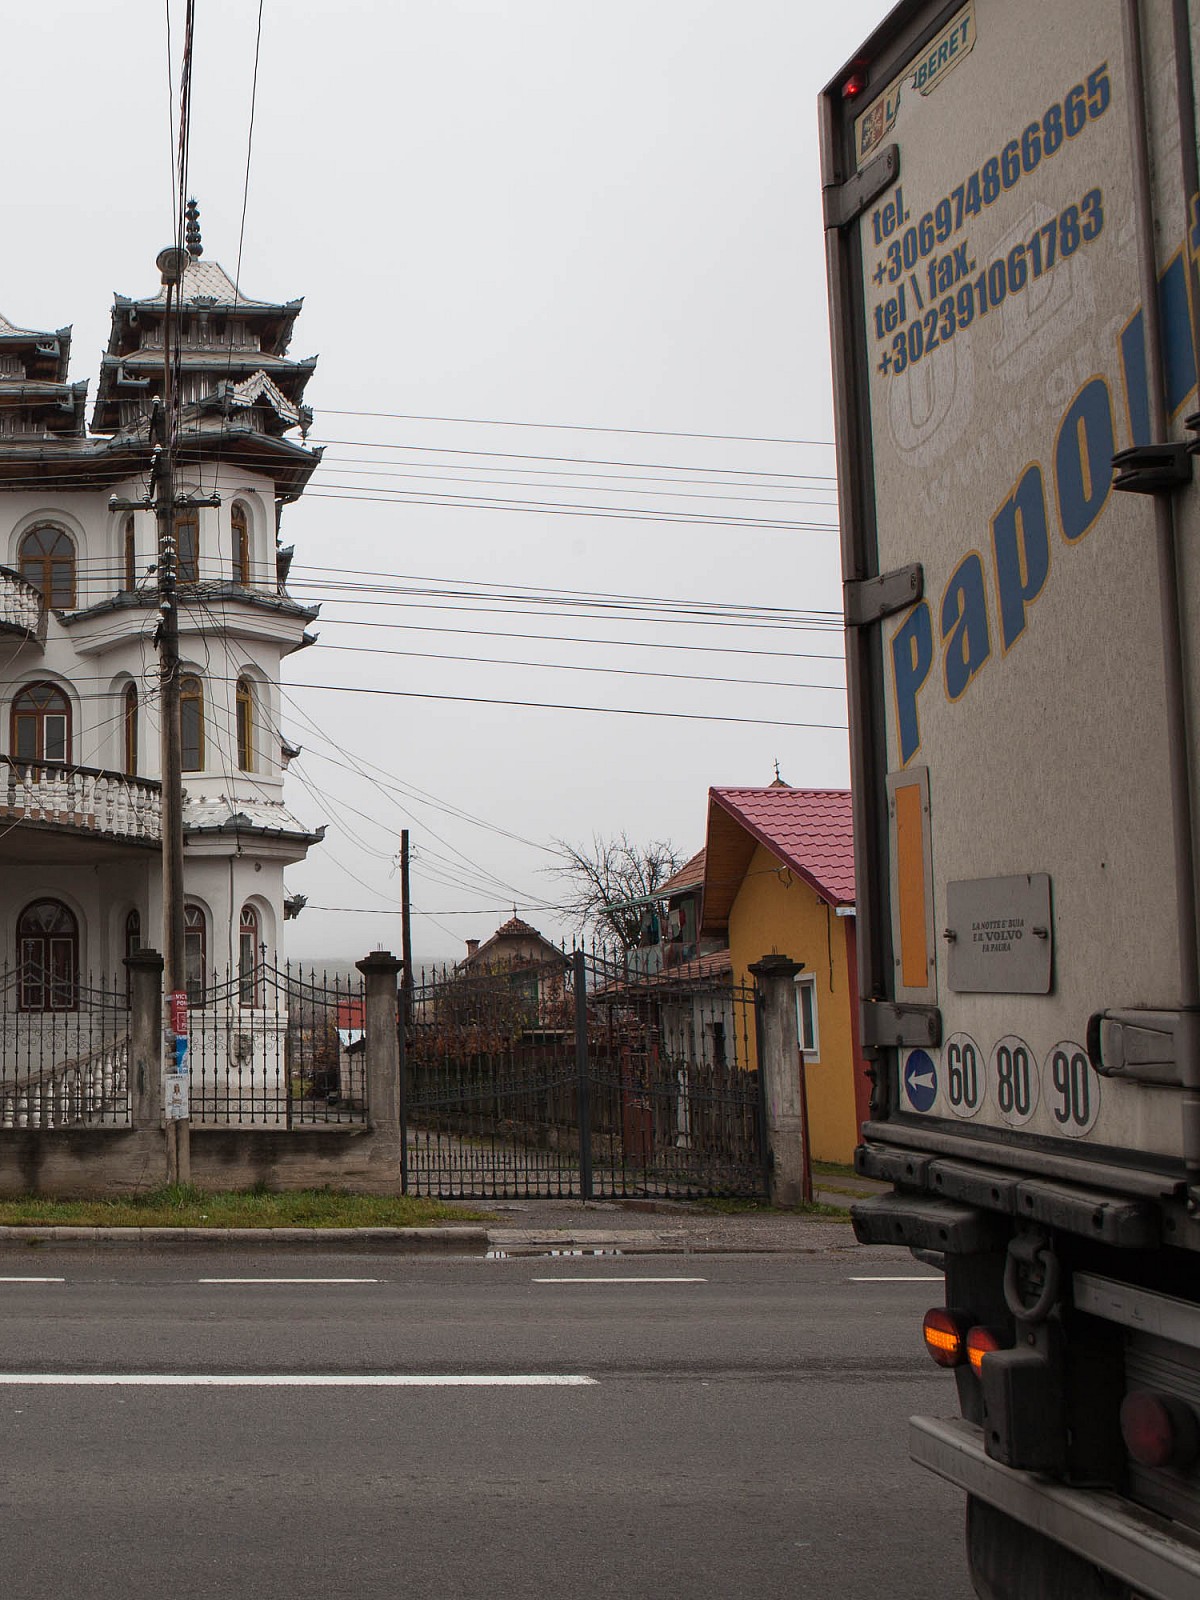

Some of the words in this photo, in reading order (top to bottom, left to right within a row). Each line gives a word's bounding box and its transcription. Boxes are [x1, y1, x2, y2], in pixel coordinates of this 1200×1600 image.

[872, 59, 1112, 288] +306974866865
[872, 185, 910, 246] tel.
[873, 281, 907, 340] tel
[926, 238, 977, 302] fax.
[877, 187, 1104, 378] +302391061783
[985, 930, 1023, 941] VOLVO
[947, 1043, 977, 1108] 60
[997, 1046, 1030, 1115] 80
[1052, 1050, 1090, 1127] 90
